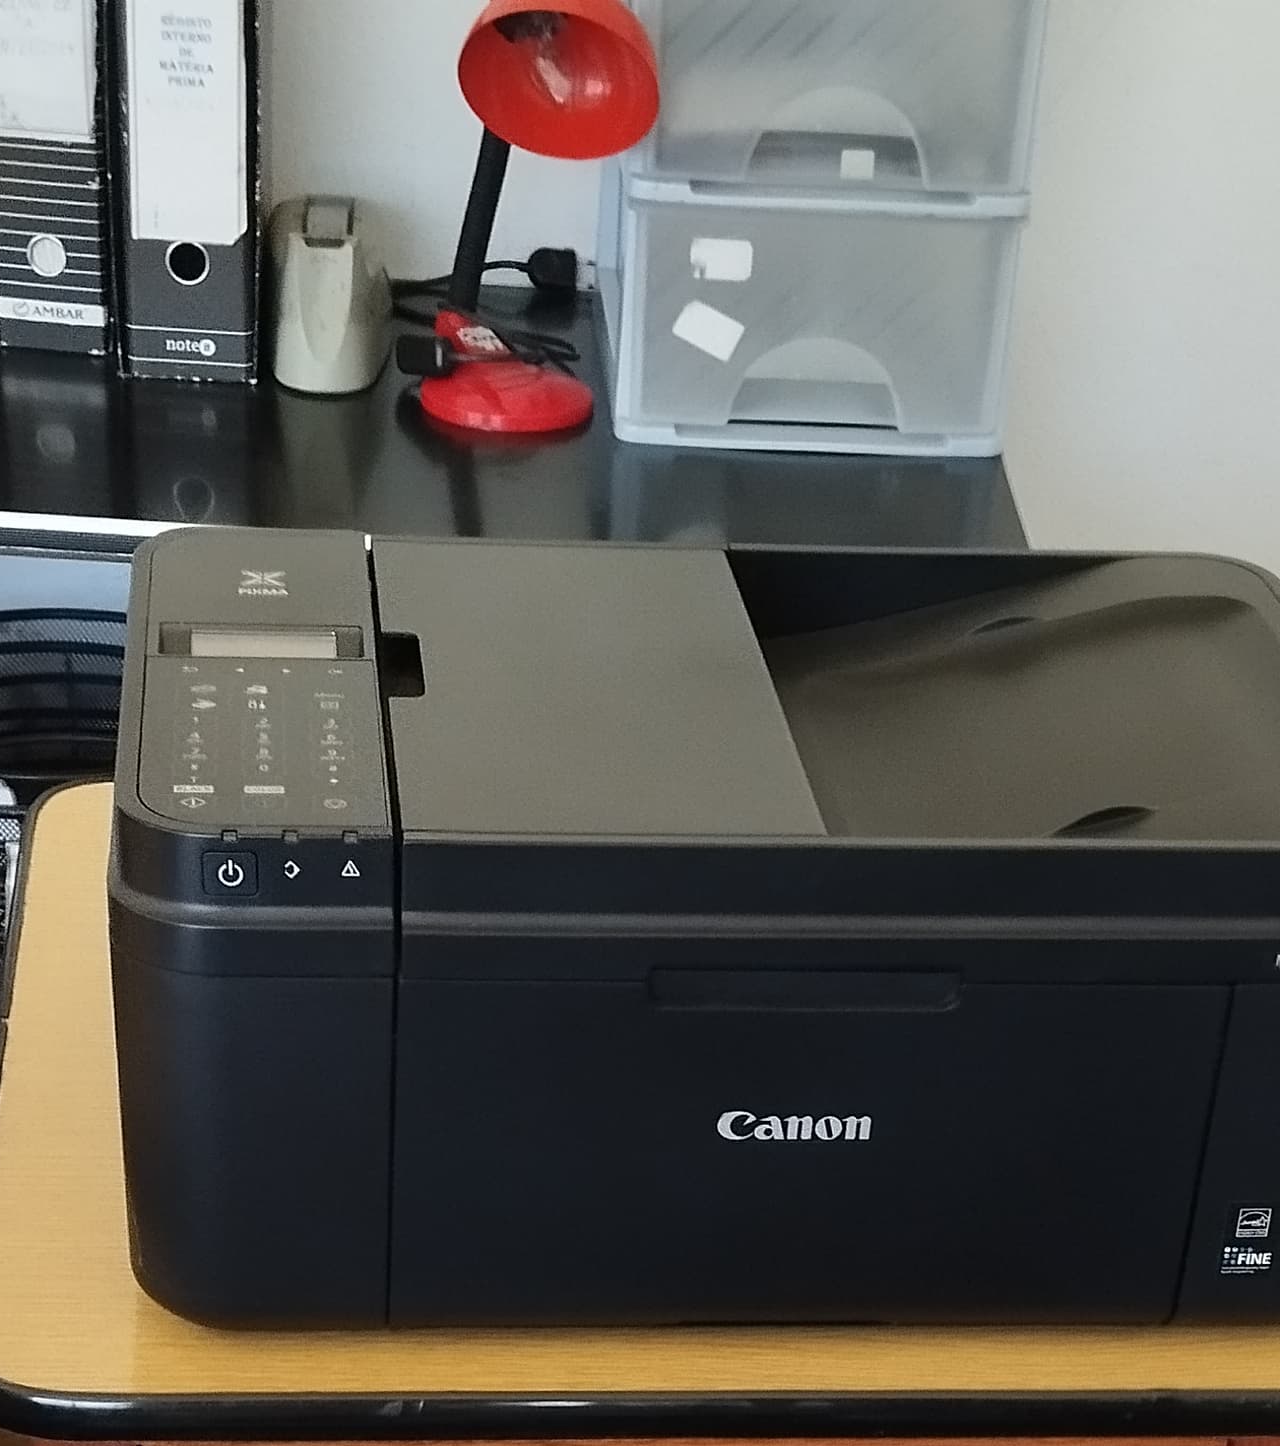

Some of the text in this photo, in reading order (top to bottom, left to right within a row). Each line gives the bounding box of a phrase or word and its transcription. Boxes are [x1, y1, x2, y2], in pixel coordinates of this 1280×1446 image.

[167, 75, 205, 88] PRIMA
[32, 305, 84, 321] AMBAR
[238, 587, 289, 596] PIXMA
[716, 1111, 871, 1141] Canon
[1237, 1252, 1272, 1265] FINE
